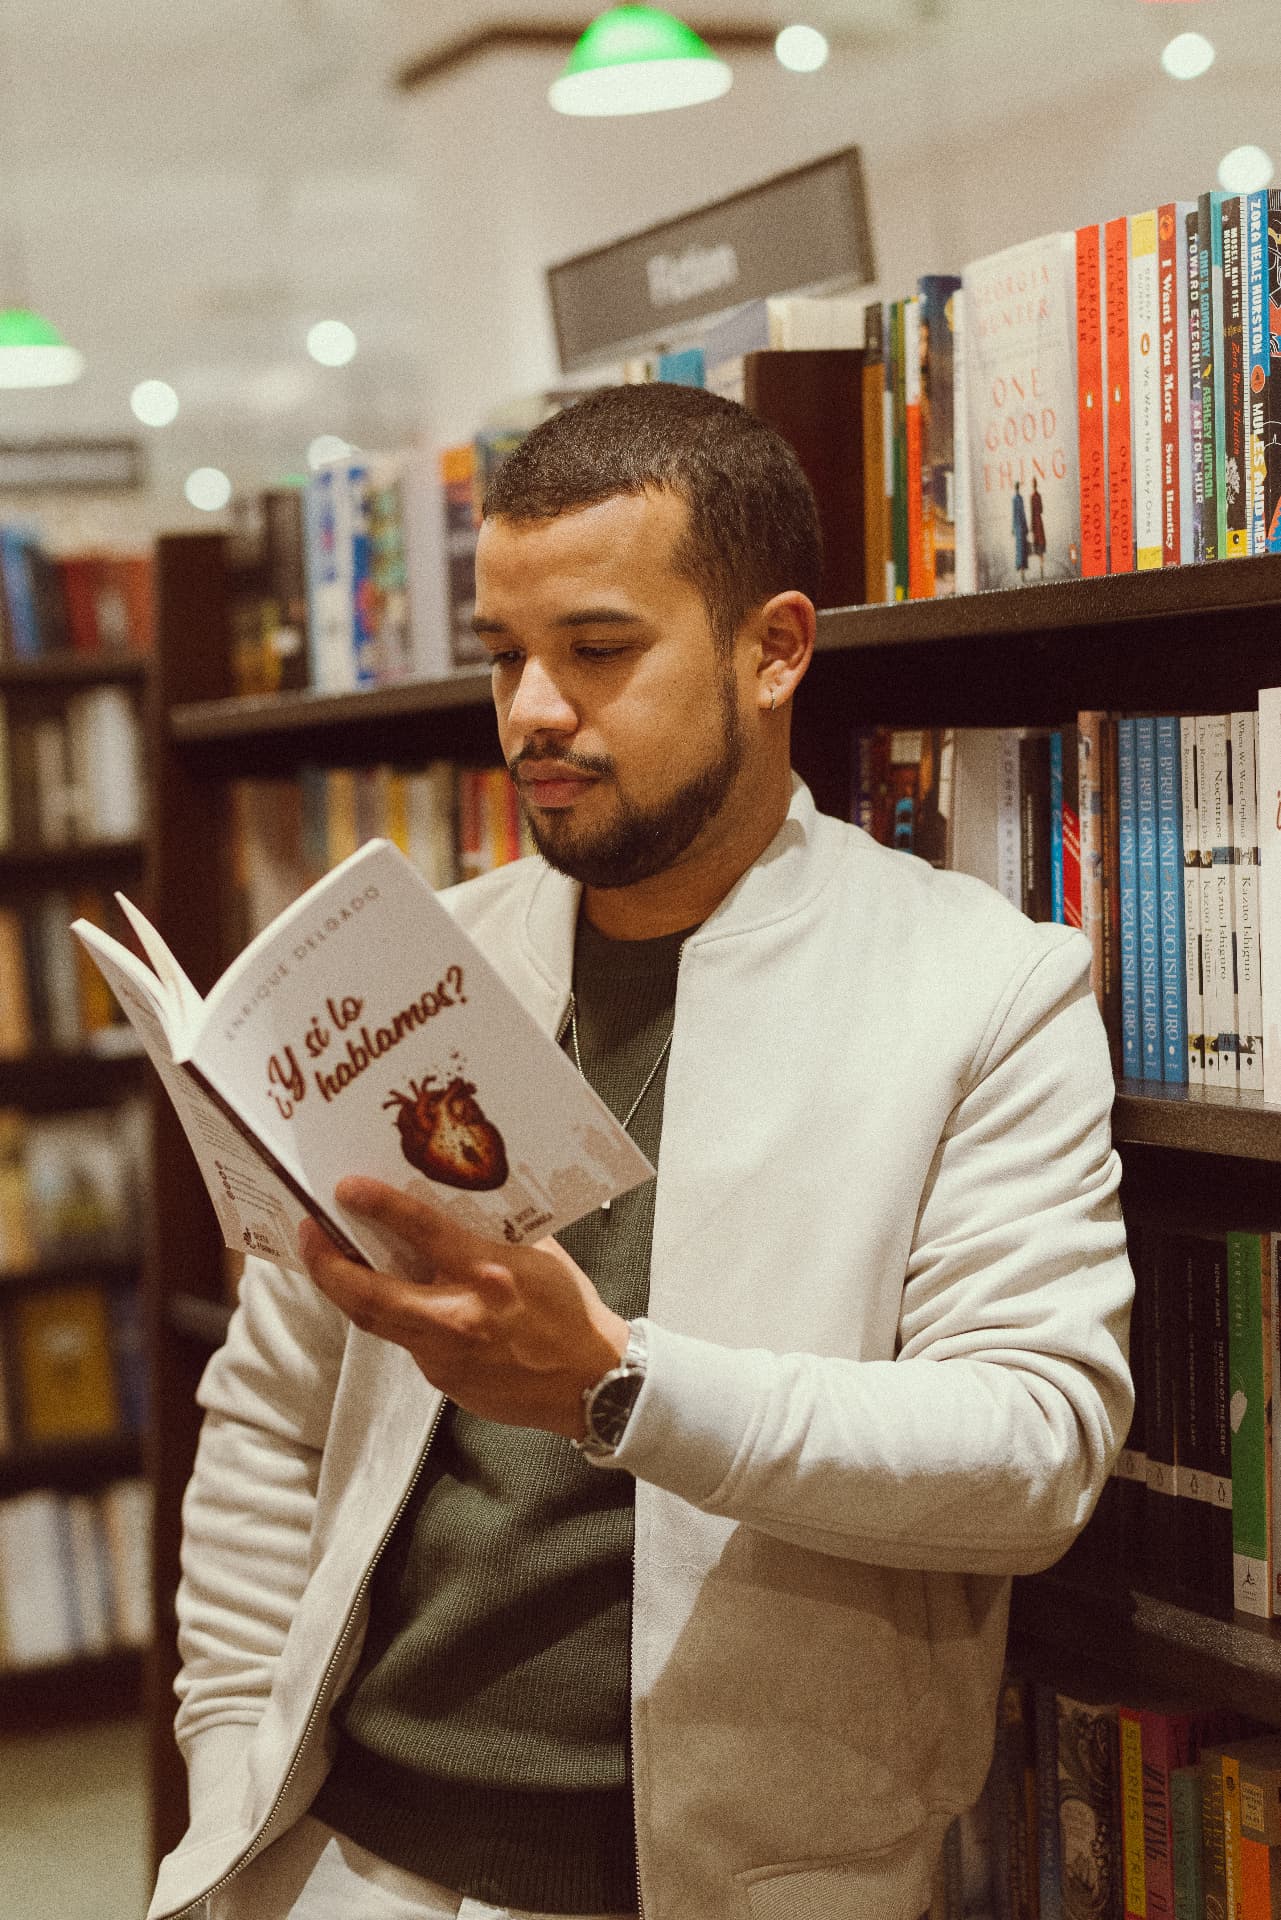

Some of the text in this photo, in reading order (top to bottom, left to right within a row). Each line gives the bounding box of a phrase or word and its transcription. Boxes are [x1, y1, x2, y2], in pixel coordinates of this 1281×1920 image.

[1223, 229, 1231, 278] MOUNTAIN
[1250, 199, 1262, 245] ZORA
[1087, 247, 1097, 345] GEORGIA
[1116, 239, 1125, 339] GEORGIA
[1200, 250, 1211, 358] ONE'S COMPANY
[1231, 267, 1239, 287] MAN
[1231, 290, 1239, 299] OF
[1162, 259, 1174, 424] I Want You More
[1189, 233, 1201, 390] TOWARD ETERNITY
[1231, 302, 1240, 319] THE
[1251, 285, 1263, 355] HURSTON
[992, 368, 1040, 408] ONE
[1232, 342, 1240, 368] Zora
[984, 407, 1056, 452] GOOD
[1193, 410, 1203, 503] ANTON HUR
[1202, 386, 1213, 498] ASHLEY HUTSON
[1232, 409, 1242, 456] Hurston
[983, 448, 1067, 493] THING
[1120, 445, 1129, 557] ONE GOOD
[1144, 458, 1152, 494] Lucky
[1165, 443, 1175, 551] Swan Huntley
[1252, 402, 1265, 554] MULES AND MEN
[1082, 475, 1090, 541] THING
[1092, 450, 1102, 561] ONE GOOD
[1111, 471, 1119, 537] THING
[1145, 500, 1153, 535] Ones
[1160, 725, 1173, 748] THE
[1161, 756, 1175, 811] BURIED
[1199, 748, 1207, 792] Remains
[1238, 719, 1248, 839] When We Were Orphans
[1214, 769, 1223, 839] Nocturnes
[1121, 815, 1133, 867] GIANT
[1140, 817, 1153, 869] GIANT
[1162, 817, 1176, 869] GIANT
[294, 886, 380, 960] DELGADO
[1122, 888, 1135, 951] KAZUO
[1142, 890, 1155, 953] KAZUO
[1163, 890, 1177, 954] KAZUO
[1186, 879, 1195, 981] Kazuo Ishiguro
[1204, 880, 1213, 984] Kazuo Ishiguro
[1217, 876, 1228, 981] Kazuo Ishiguro
[1241, 877, 1253, 982] Kazuo Ishiguro
[305, 1016, 330, 1058] si
[326, 994, 363, 1031] lo
[1123, 954, 1137, 1036] ISHIGURO
[1143, 957, 1156, 1039] ISHIGURO
[1164, 958, 1179, 1041] ISHIGURO
[313, 964, 469, 1102] hablamos?
[1219, 1388, 1225, 1401] OF
[1127, 1727, 1142, 1906] STORIES TRUE
